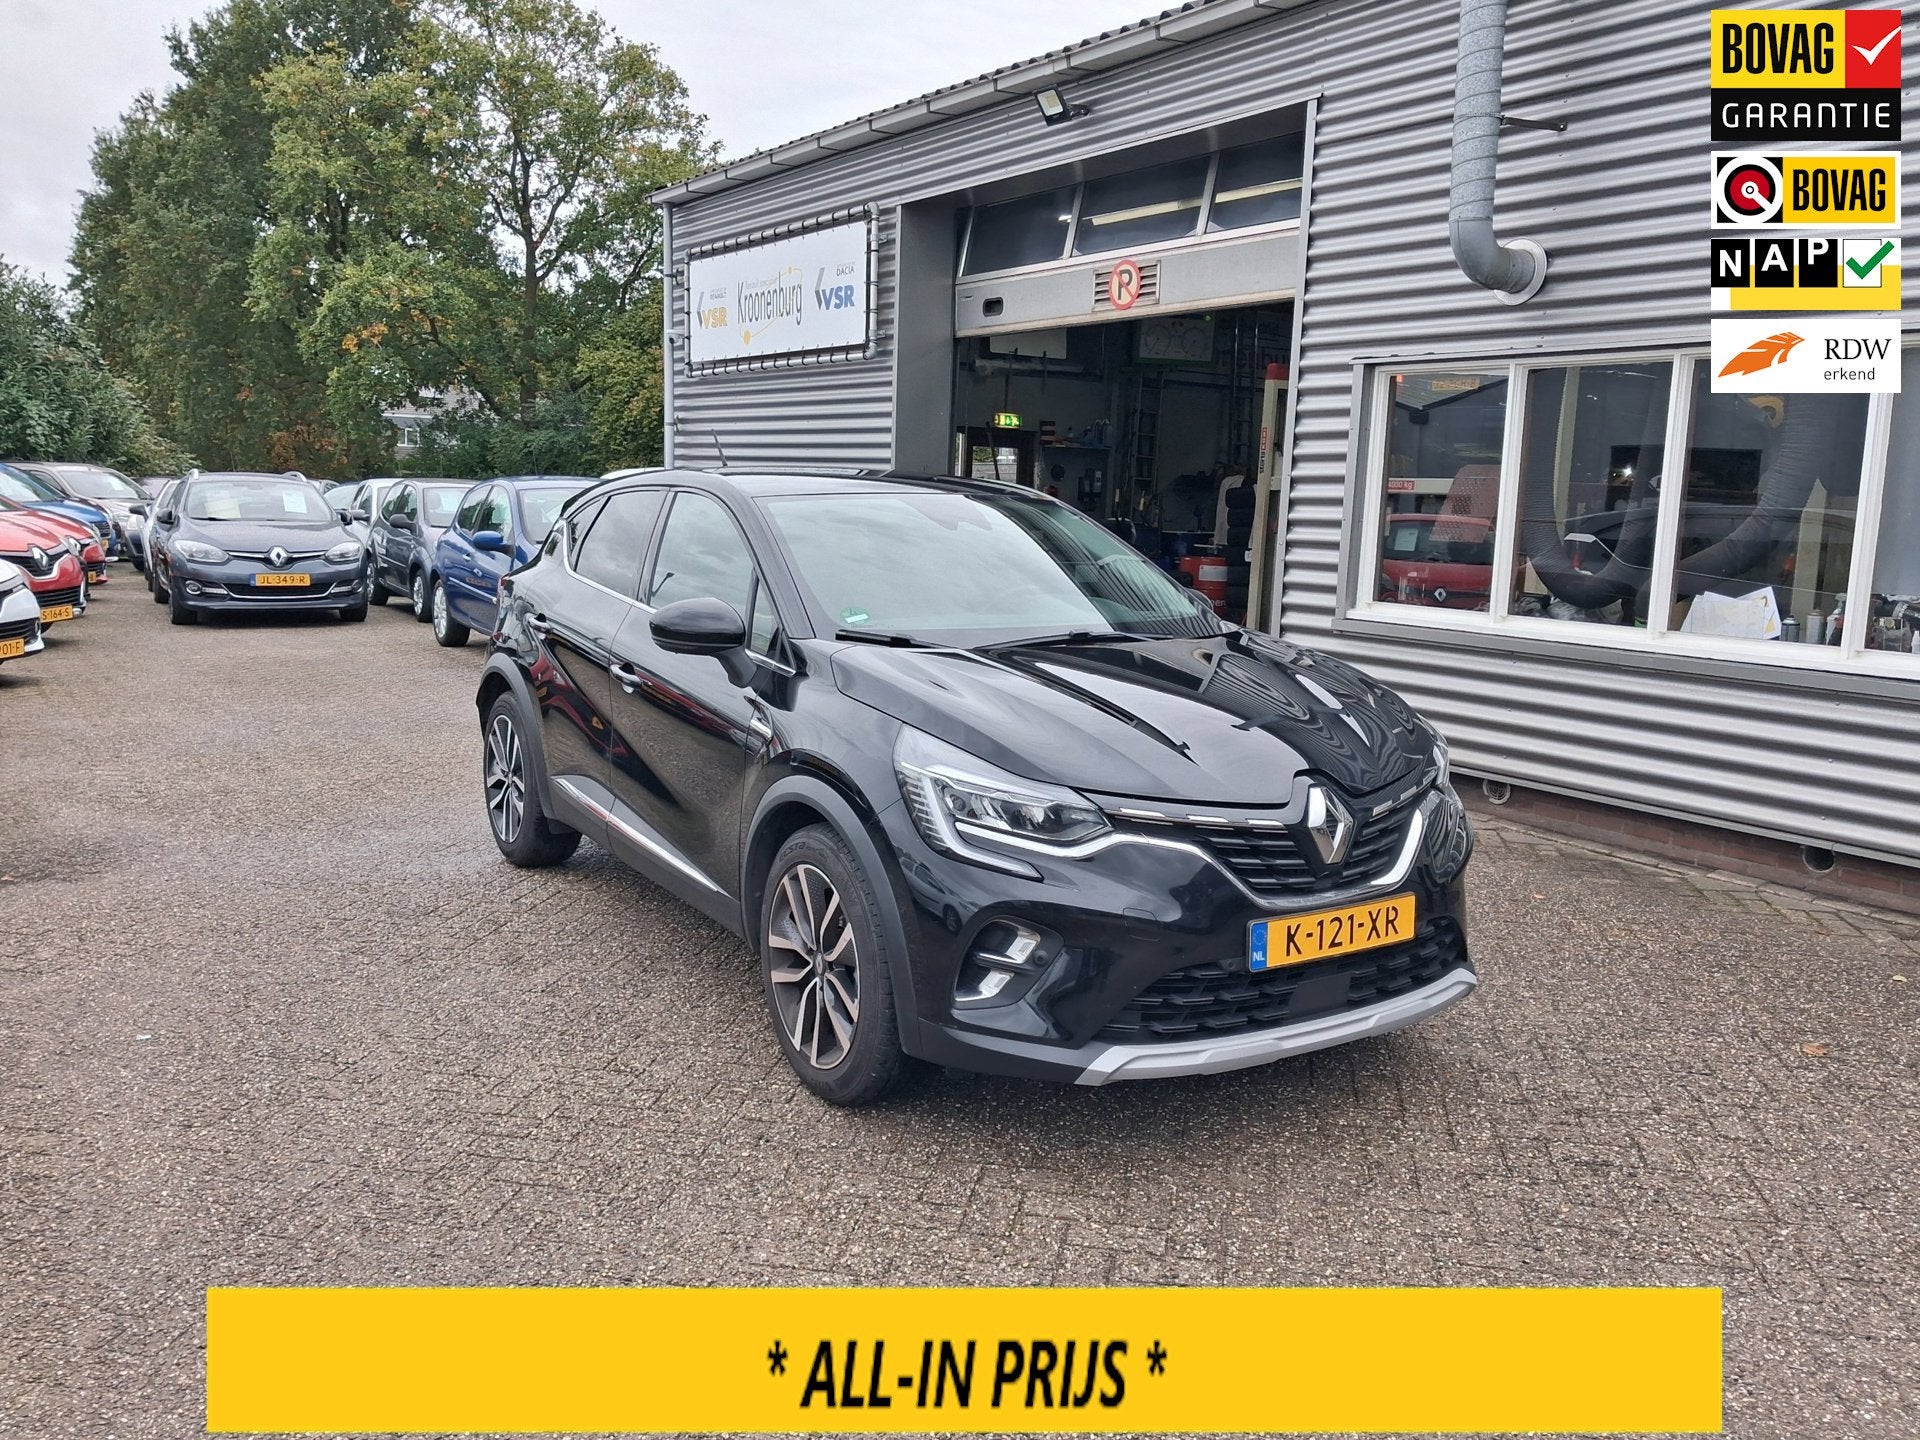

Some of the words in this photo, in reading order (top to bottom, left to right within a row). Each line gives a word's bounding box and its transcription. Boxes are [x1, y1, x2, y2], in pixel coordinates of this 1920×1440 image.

[836, 265, 855, 277] DACIA
[737, 271, 802, 326] Kroonenburg
[821, 284, 856, 311] VSR
[701, 306, 728, 329] VSR
[1403, 480, 1413, 490] kg
[1285, 905, 1399, 957] K-121-XR
[1252, 950, 1266, 962] NL
